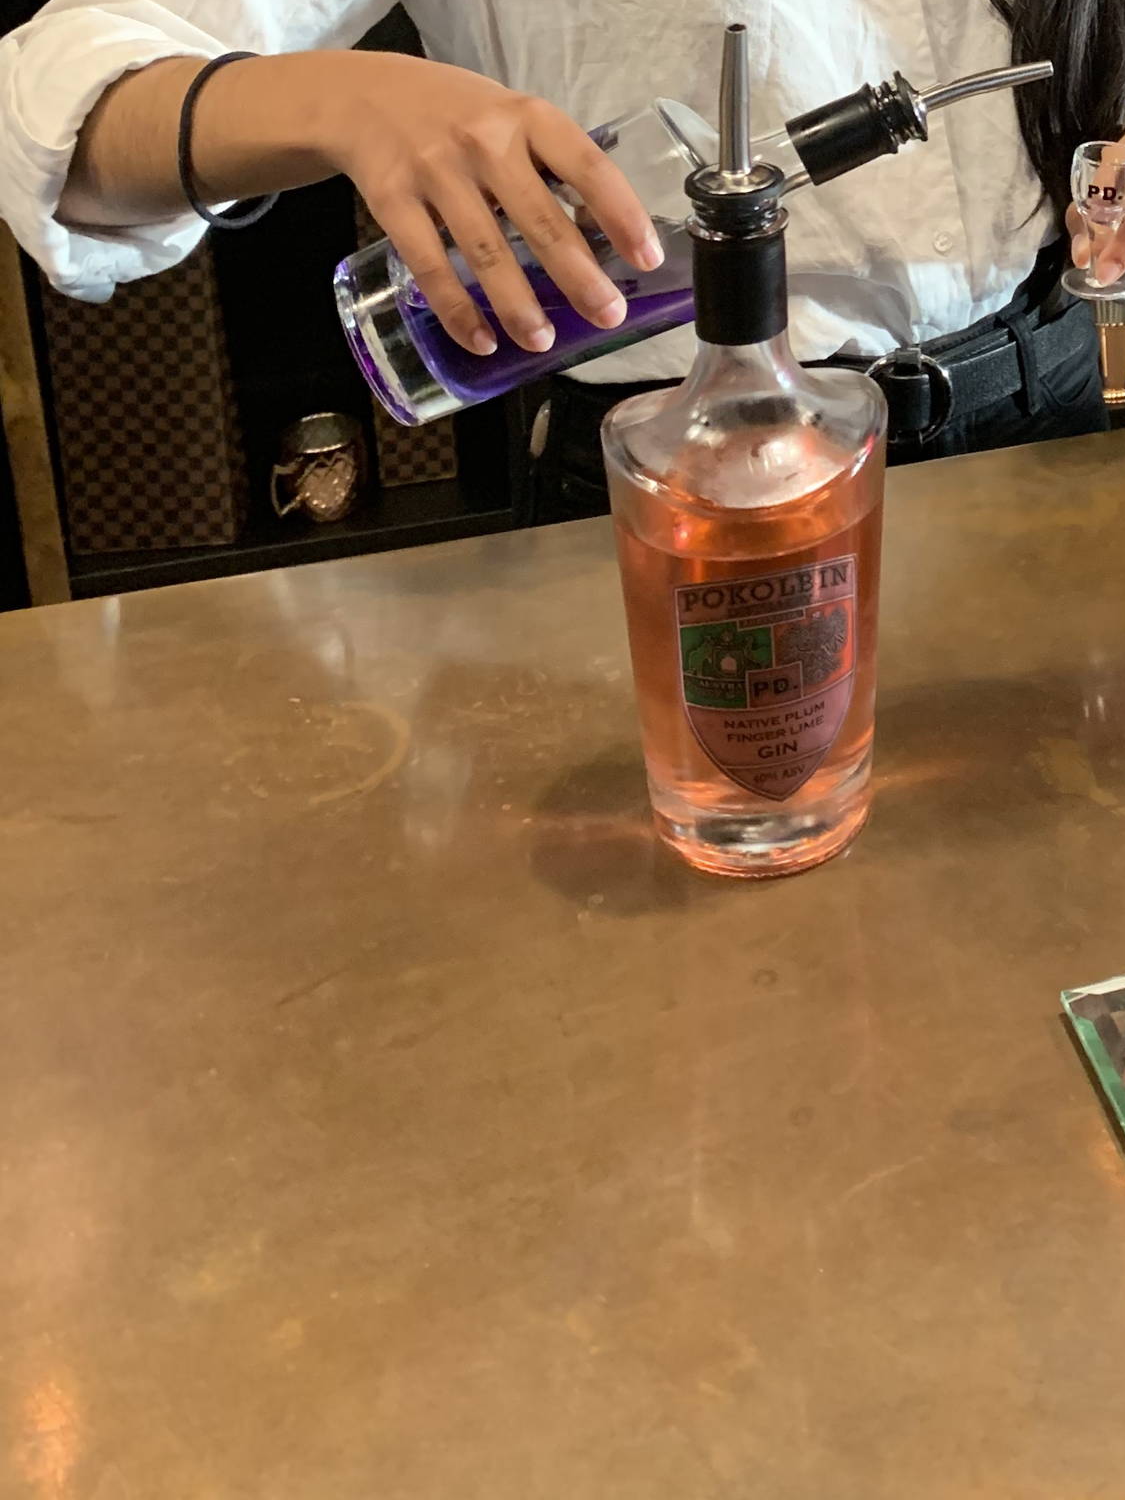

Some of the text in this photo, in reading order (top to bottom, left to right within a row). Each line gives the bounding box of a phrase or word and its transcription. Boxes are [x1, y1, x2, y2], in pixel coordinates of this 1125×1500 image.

[1087, 183, 1123, 201] PD.
[682, 562, 849, 613] POKOLBIN
[752, 677, 799, 698] PD.
[724, 700, 826, 730] NATIVE PLUM
[726, 714, 825, 744] FINGER LIME
[757, 740, 799, 759] GIN
